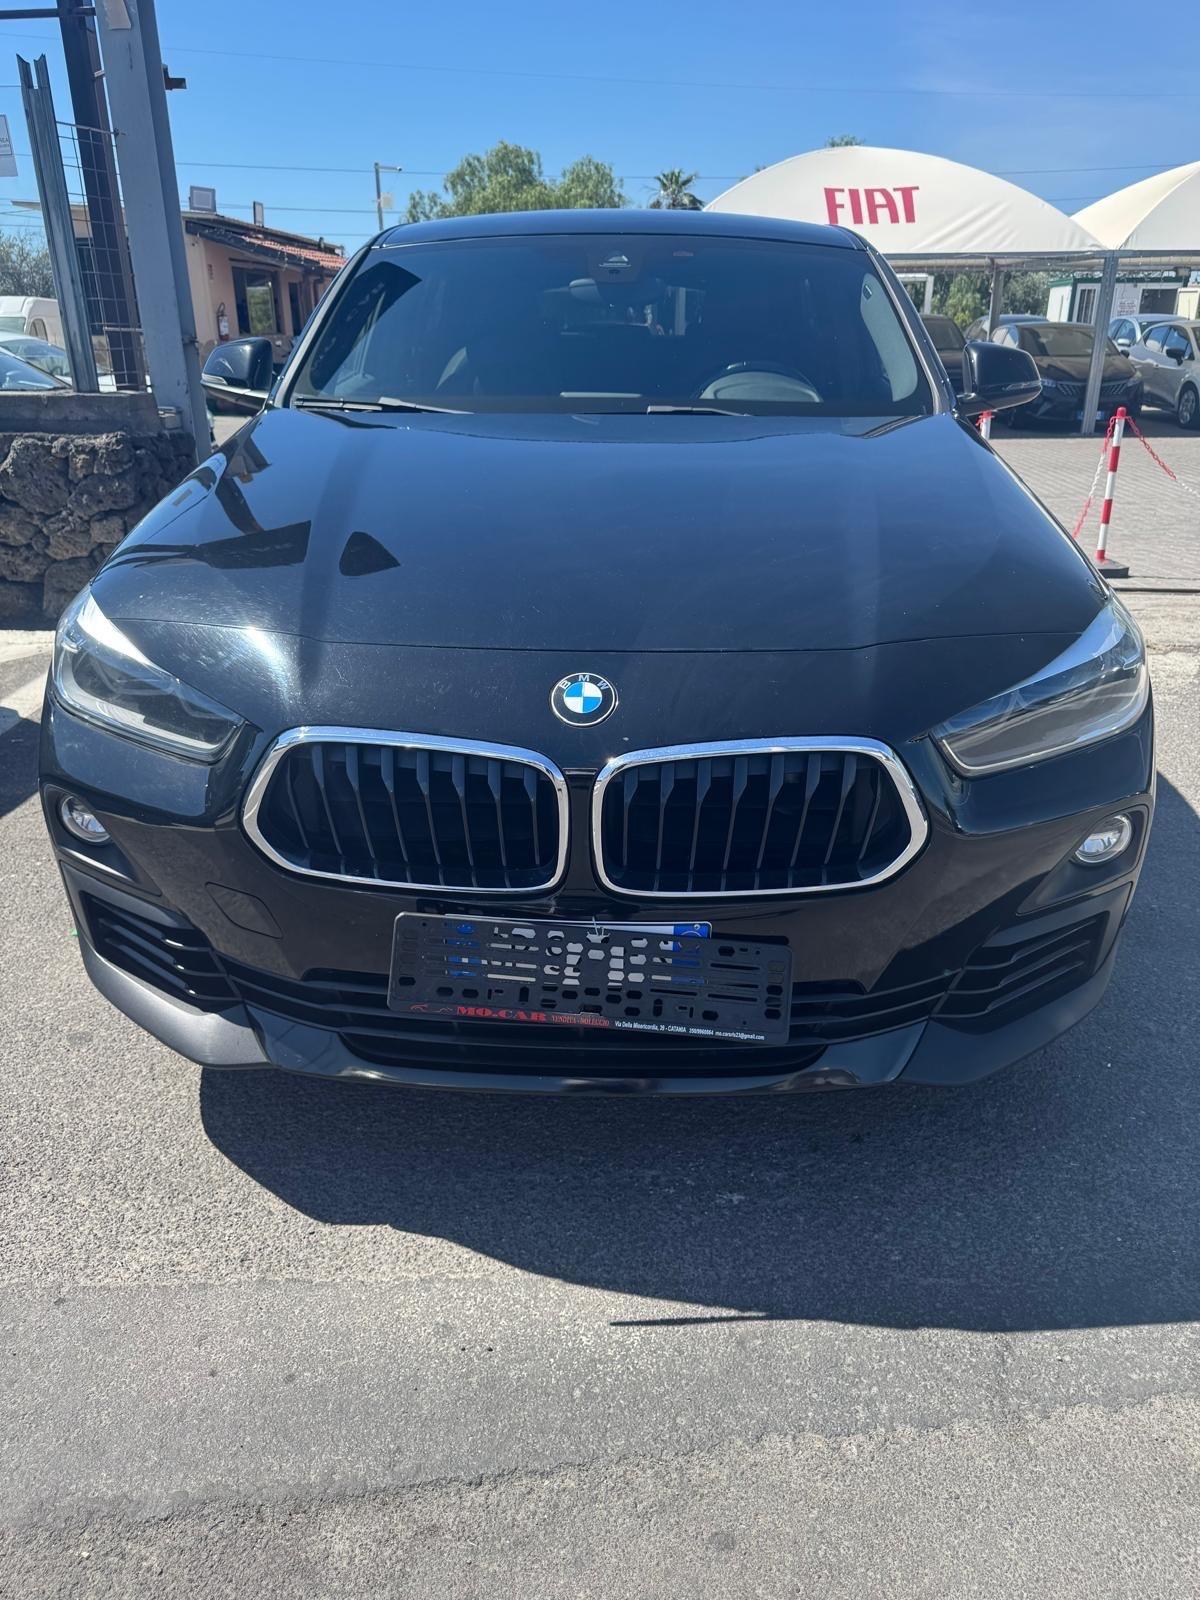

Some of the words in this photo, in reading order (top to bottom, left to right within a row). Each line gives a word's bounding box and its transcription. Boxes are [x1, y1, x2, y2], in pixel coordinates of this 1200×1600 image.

[824, 186, 920, 224] FIAT
[558, 674, 610, 690] BMW
[668, 1025, 687, 1033] CATANIA
